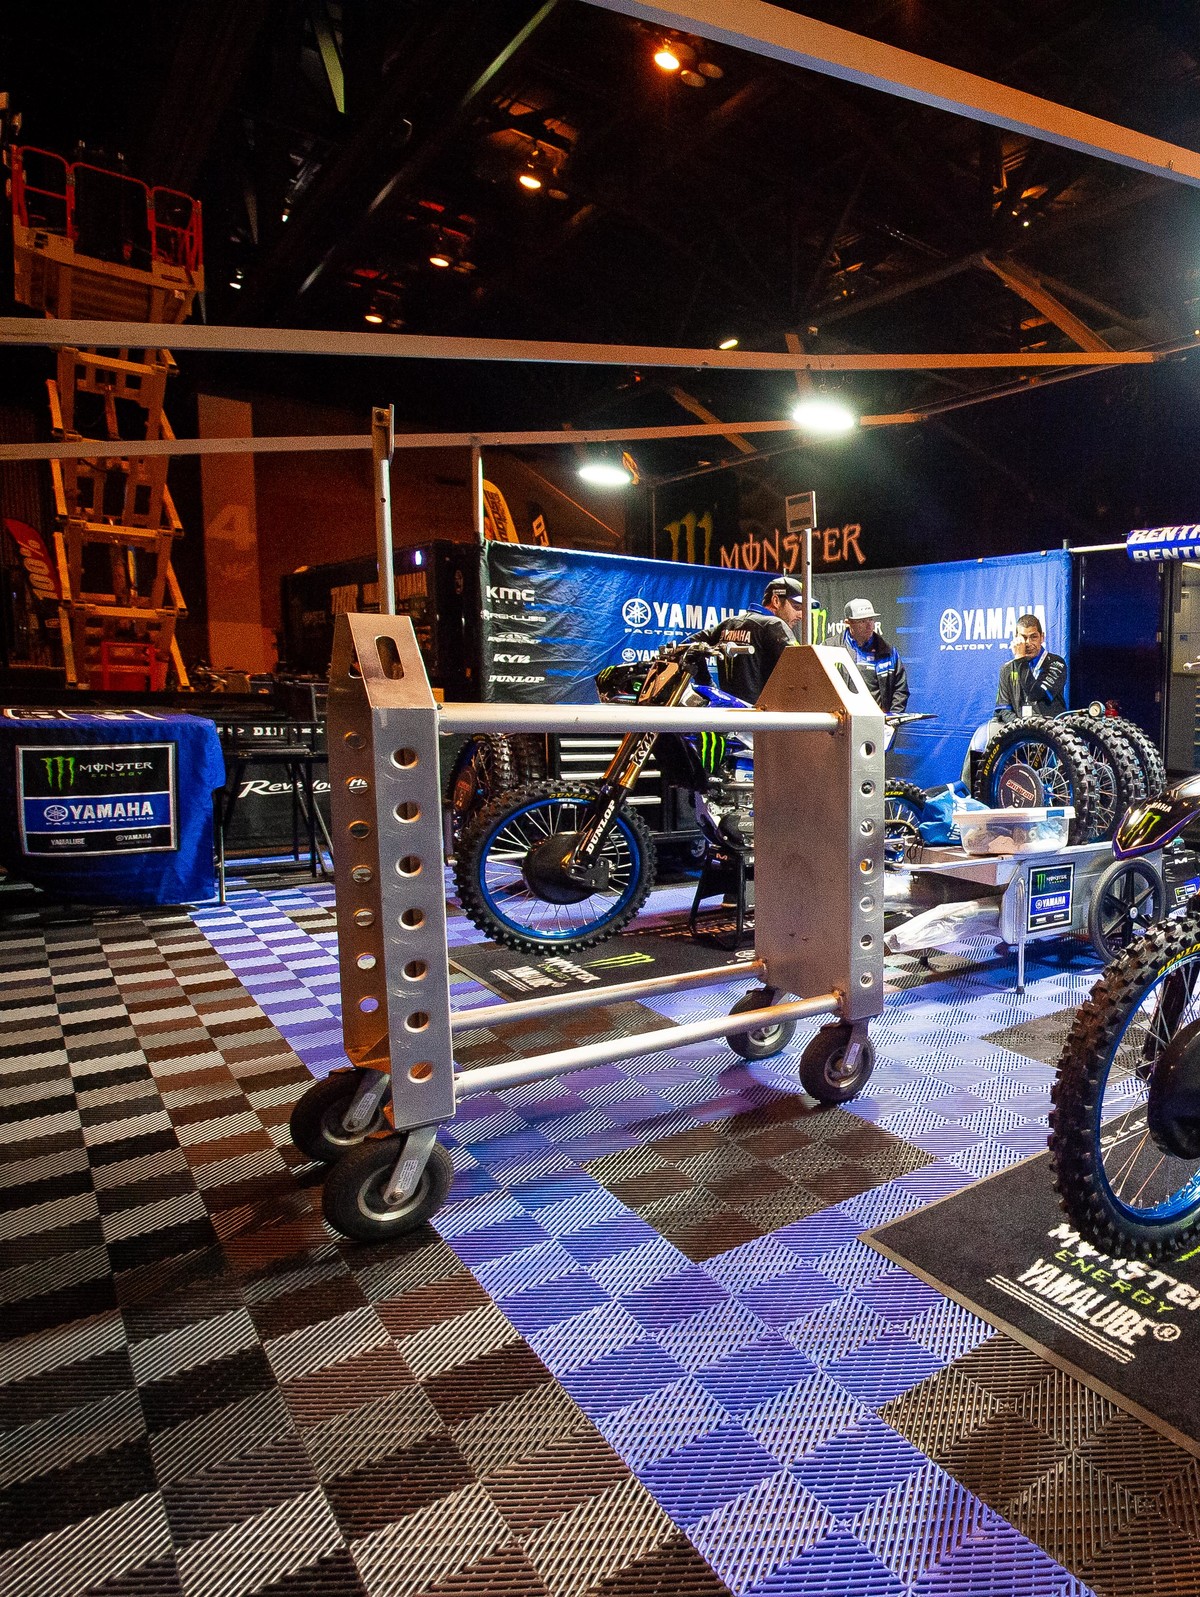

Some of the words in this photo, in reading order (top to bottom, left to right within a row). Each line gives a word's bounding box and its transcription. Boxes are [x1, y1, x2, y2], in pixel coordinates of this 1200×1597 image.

[963, 604, 1047, 641] YAMAA
[624, 628, 692, 637] FACTORY
[940, 643, 993, 651] FACTORY
[488, 674, 545, 683] DUNLOP
[79, 761, 154, 773] MONSTER
[69, 801, 154, 820] YAMAHA
[585, 799, 616, 855] DUNLOP
[1055, 1249, 1176, 1313] ENERGY
